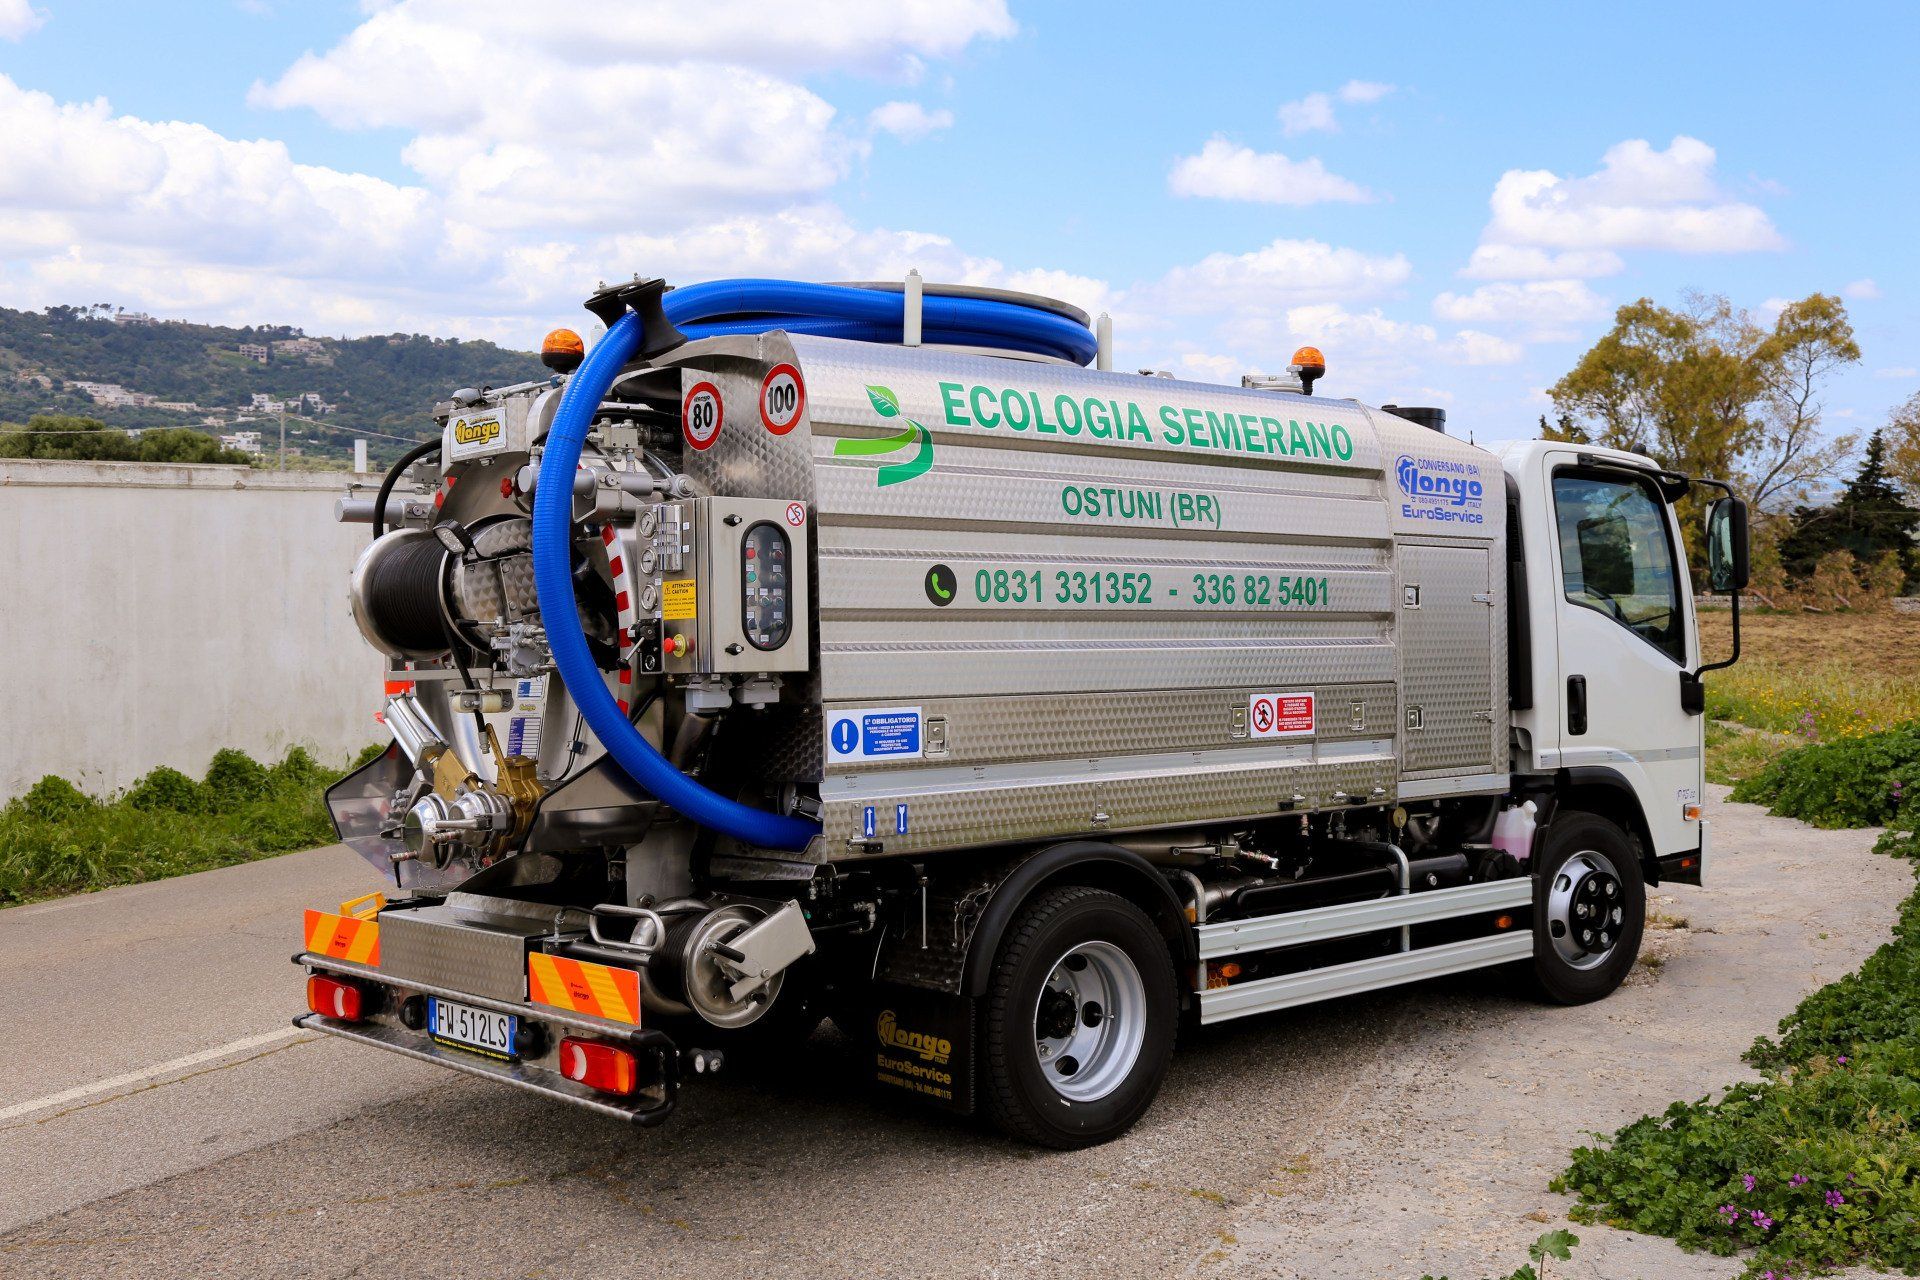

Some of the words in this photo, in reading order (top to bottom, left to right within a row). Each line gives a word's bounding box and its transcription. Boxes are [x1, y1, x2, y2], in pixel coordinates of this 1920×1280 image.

[768, 383, 796, 415] 100
[693, 402, 713, 429] 80
[940, 381, 1154, 443] ECOLOGIA
[1160, 404, 1355, 462] SEMERANO
[1418, 459, 1465, 474] CONVERSANO
[1061, 486, 1163, 519] OSTUNI
[1170, 493, 1222, 529] (BR)
[1402, 504, 1484, 524] EuroService
[975, 569, 1042, 603] 0831
[1056, 571, 1153, 605] 331352
[1193, 574, 1236, 605] 336
[1244, 575, 1271, 605] 82
[1278, 577, 1328, 606] 5401
[872, 716, 917, 725] OBBLIGATORIO
[437, 1002, 454, 1035] FW
[460, 1009, 507, 1048] 512LS
[877, 1053, 952, 1085] EuroService
